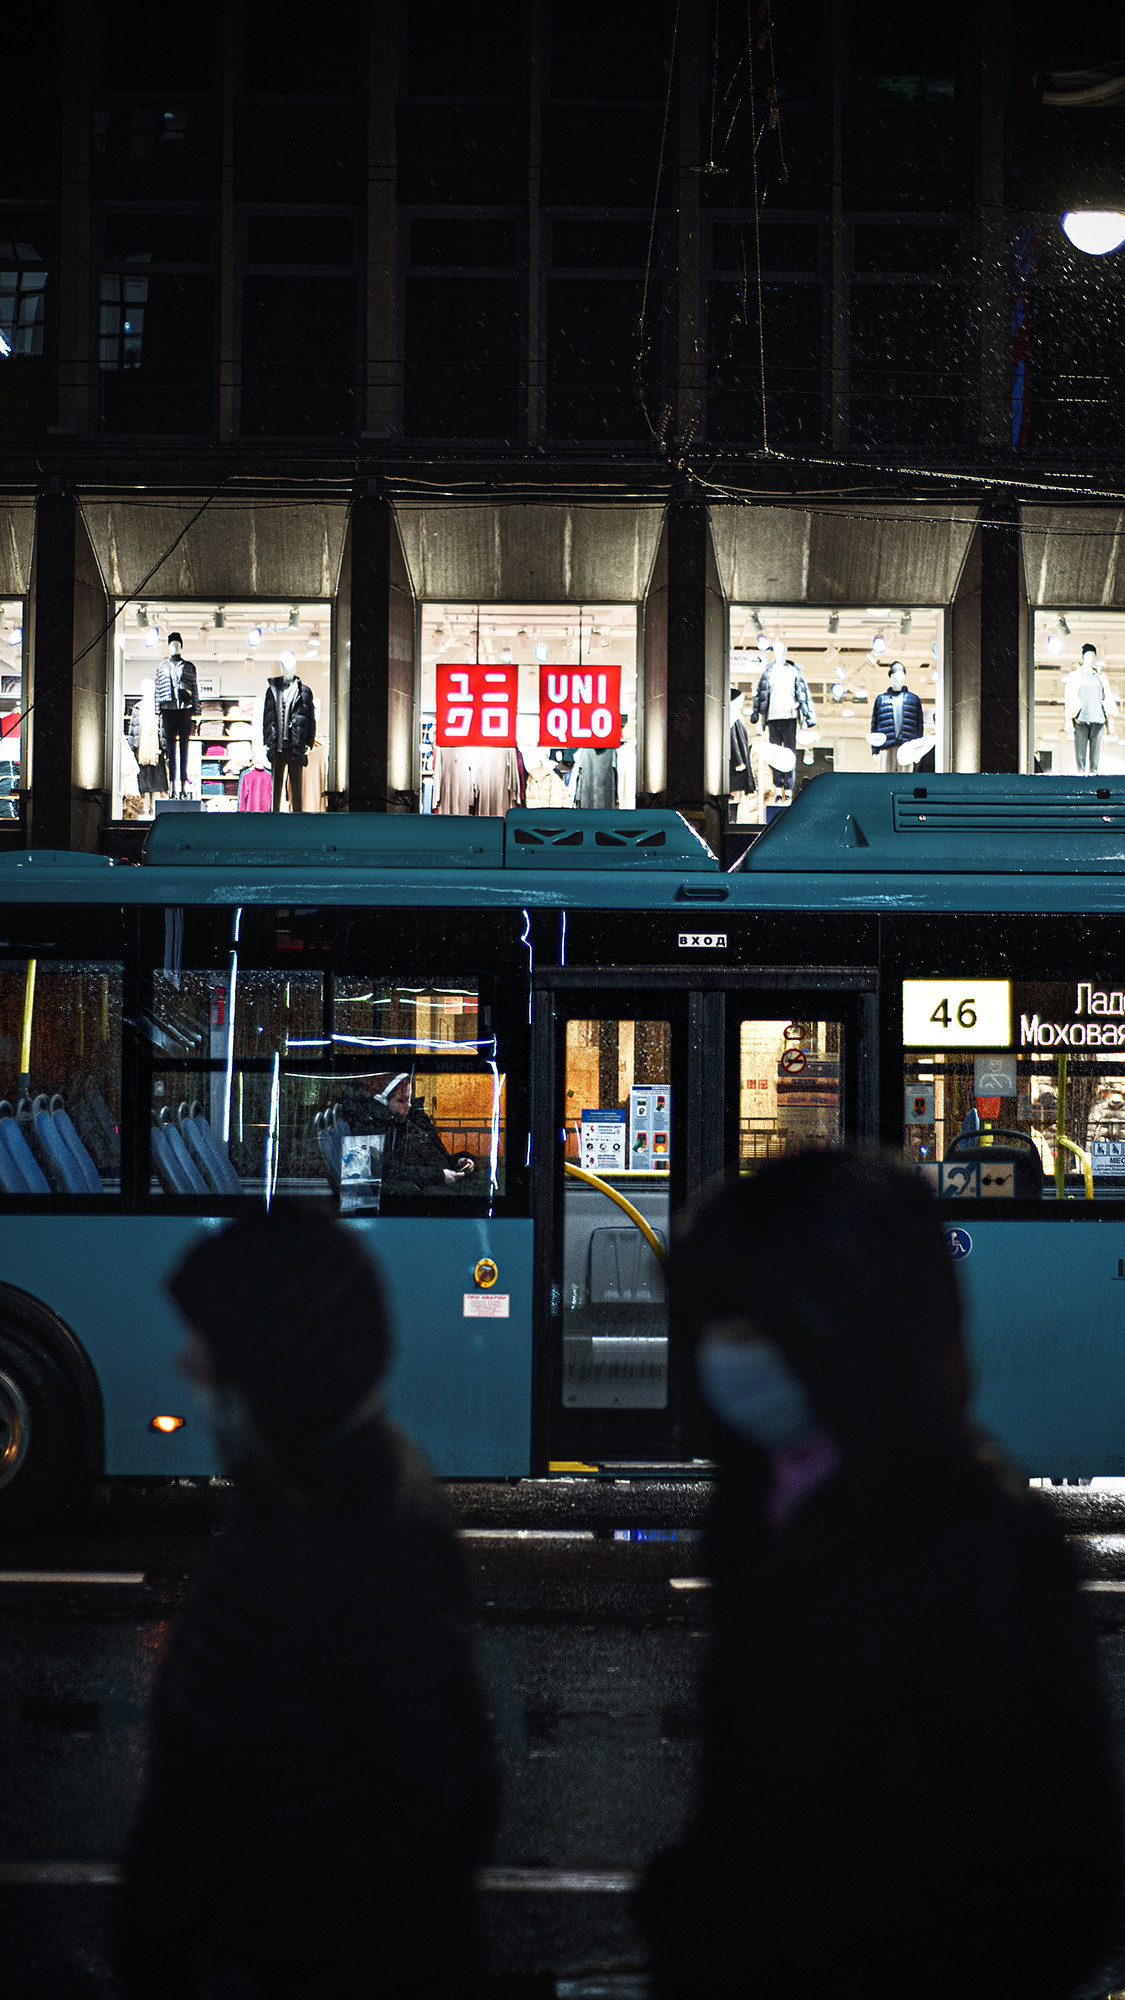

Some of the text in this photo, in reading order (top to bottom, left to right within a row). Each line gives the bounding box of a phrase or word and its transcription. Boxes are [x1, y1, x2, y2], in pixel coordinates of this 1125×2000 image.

[446, 673, 509, 702] ユニ
[547, 674, 607, 704] UNI
[444, 707, 509, 737] クロ
[546, 707, 613, 742] QLO
[679, 936, 726, 947] ВХОД
[929, 998, 977, 1028] 46
[1074, 982, 1125, 1015] Лад
[1020, 1014, 1125, 1046] Моховая
